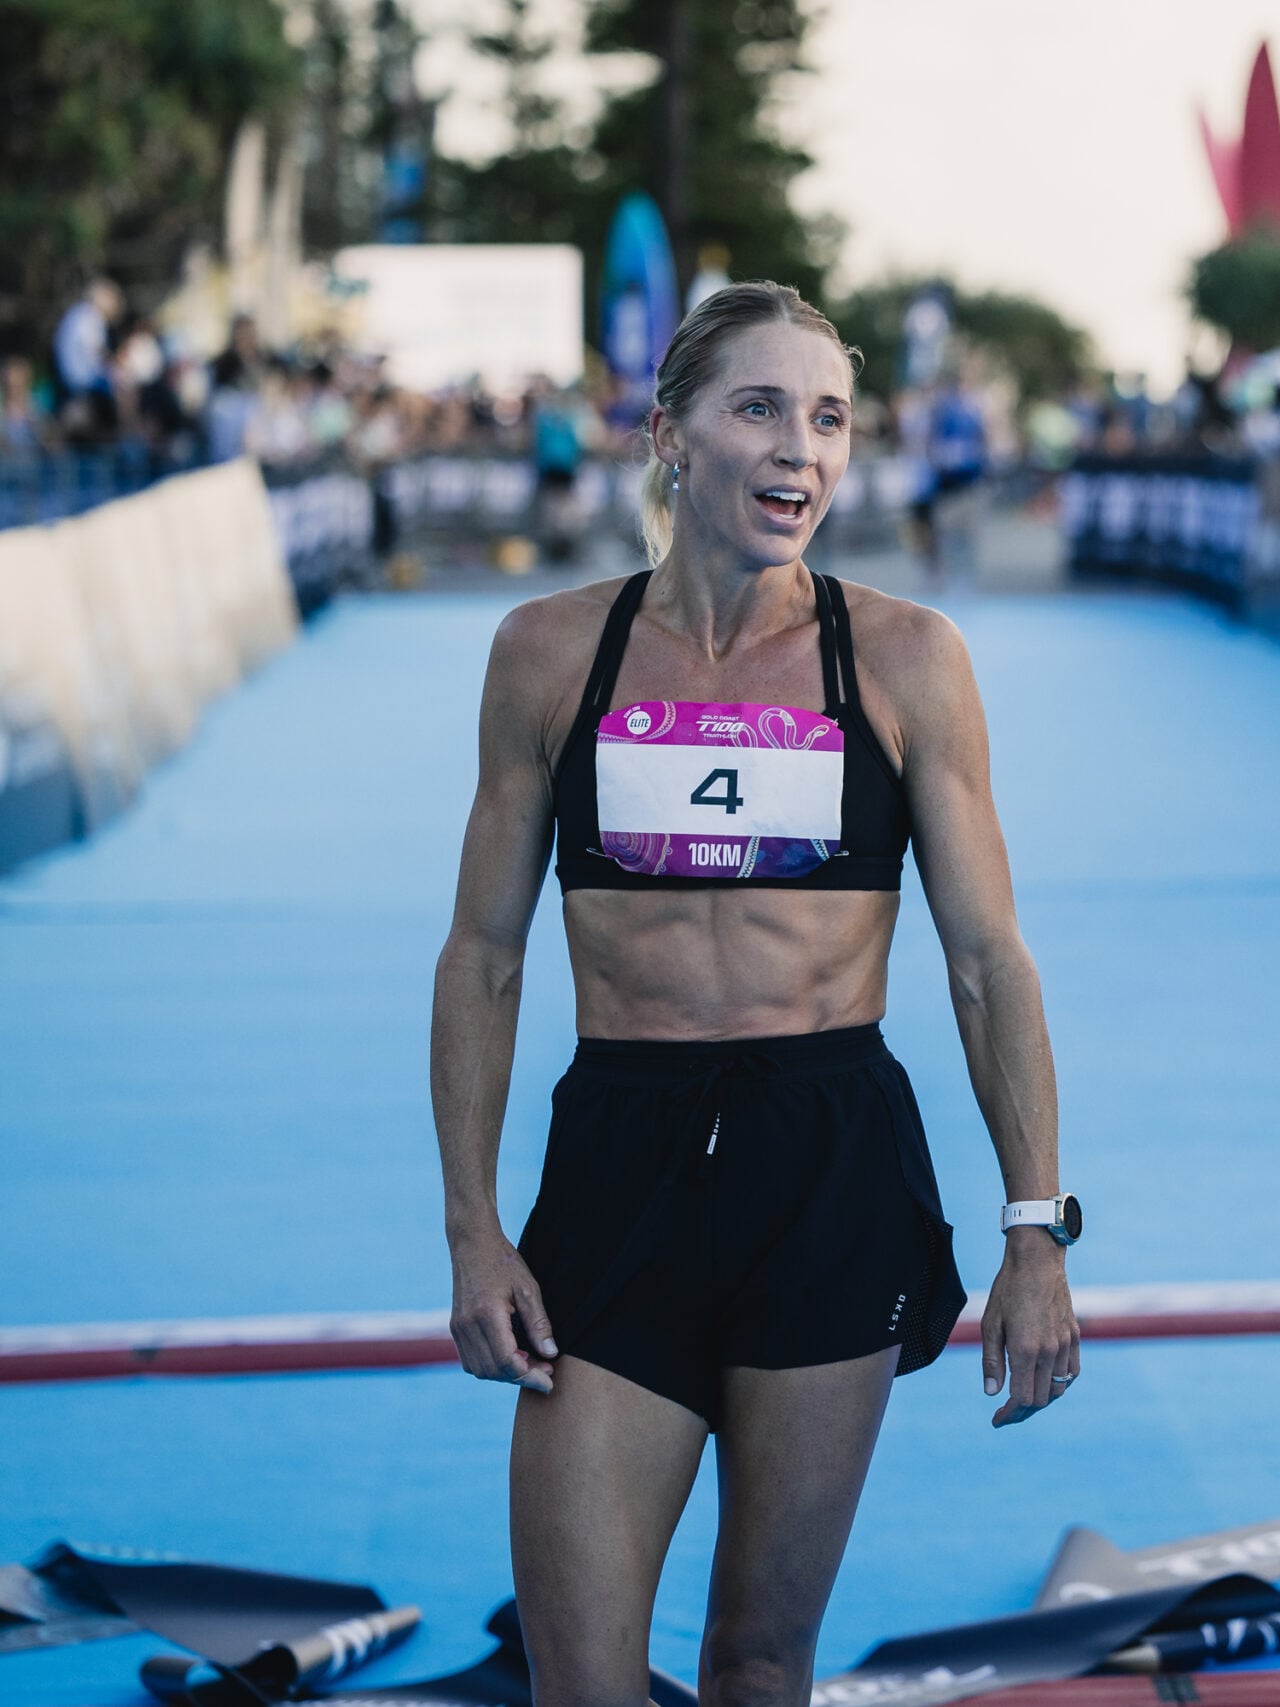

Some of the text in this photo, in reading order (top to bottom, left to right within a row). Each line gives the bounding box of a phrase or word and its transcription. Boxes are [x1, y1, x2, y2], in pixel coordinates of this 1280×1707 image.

[630, 718, 649, 728] ELITE
[696, 721, 745, 733] T100
[690, 768, 744, 815] 4
[688, 843, 741, 867] 10KM
